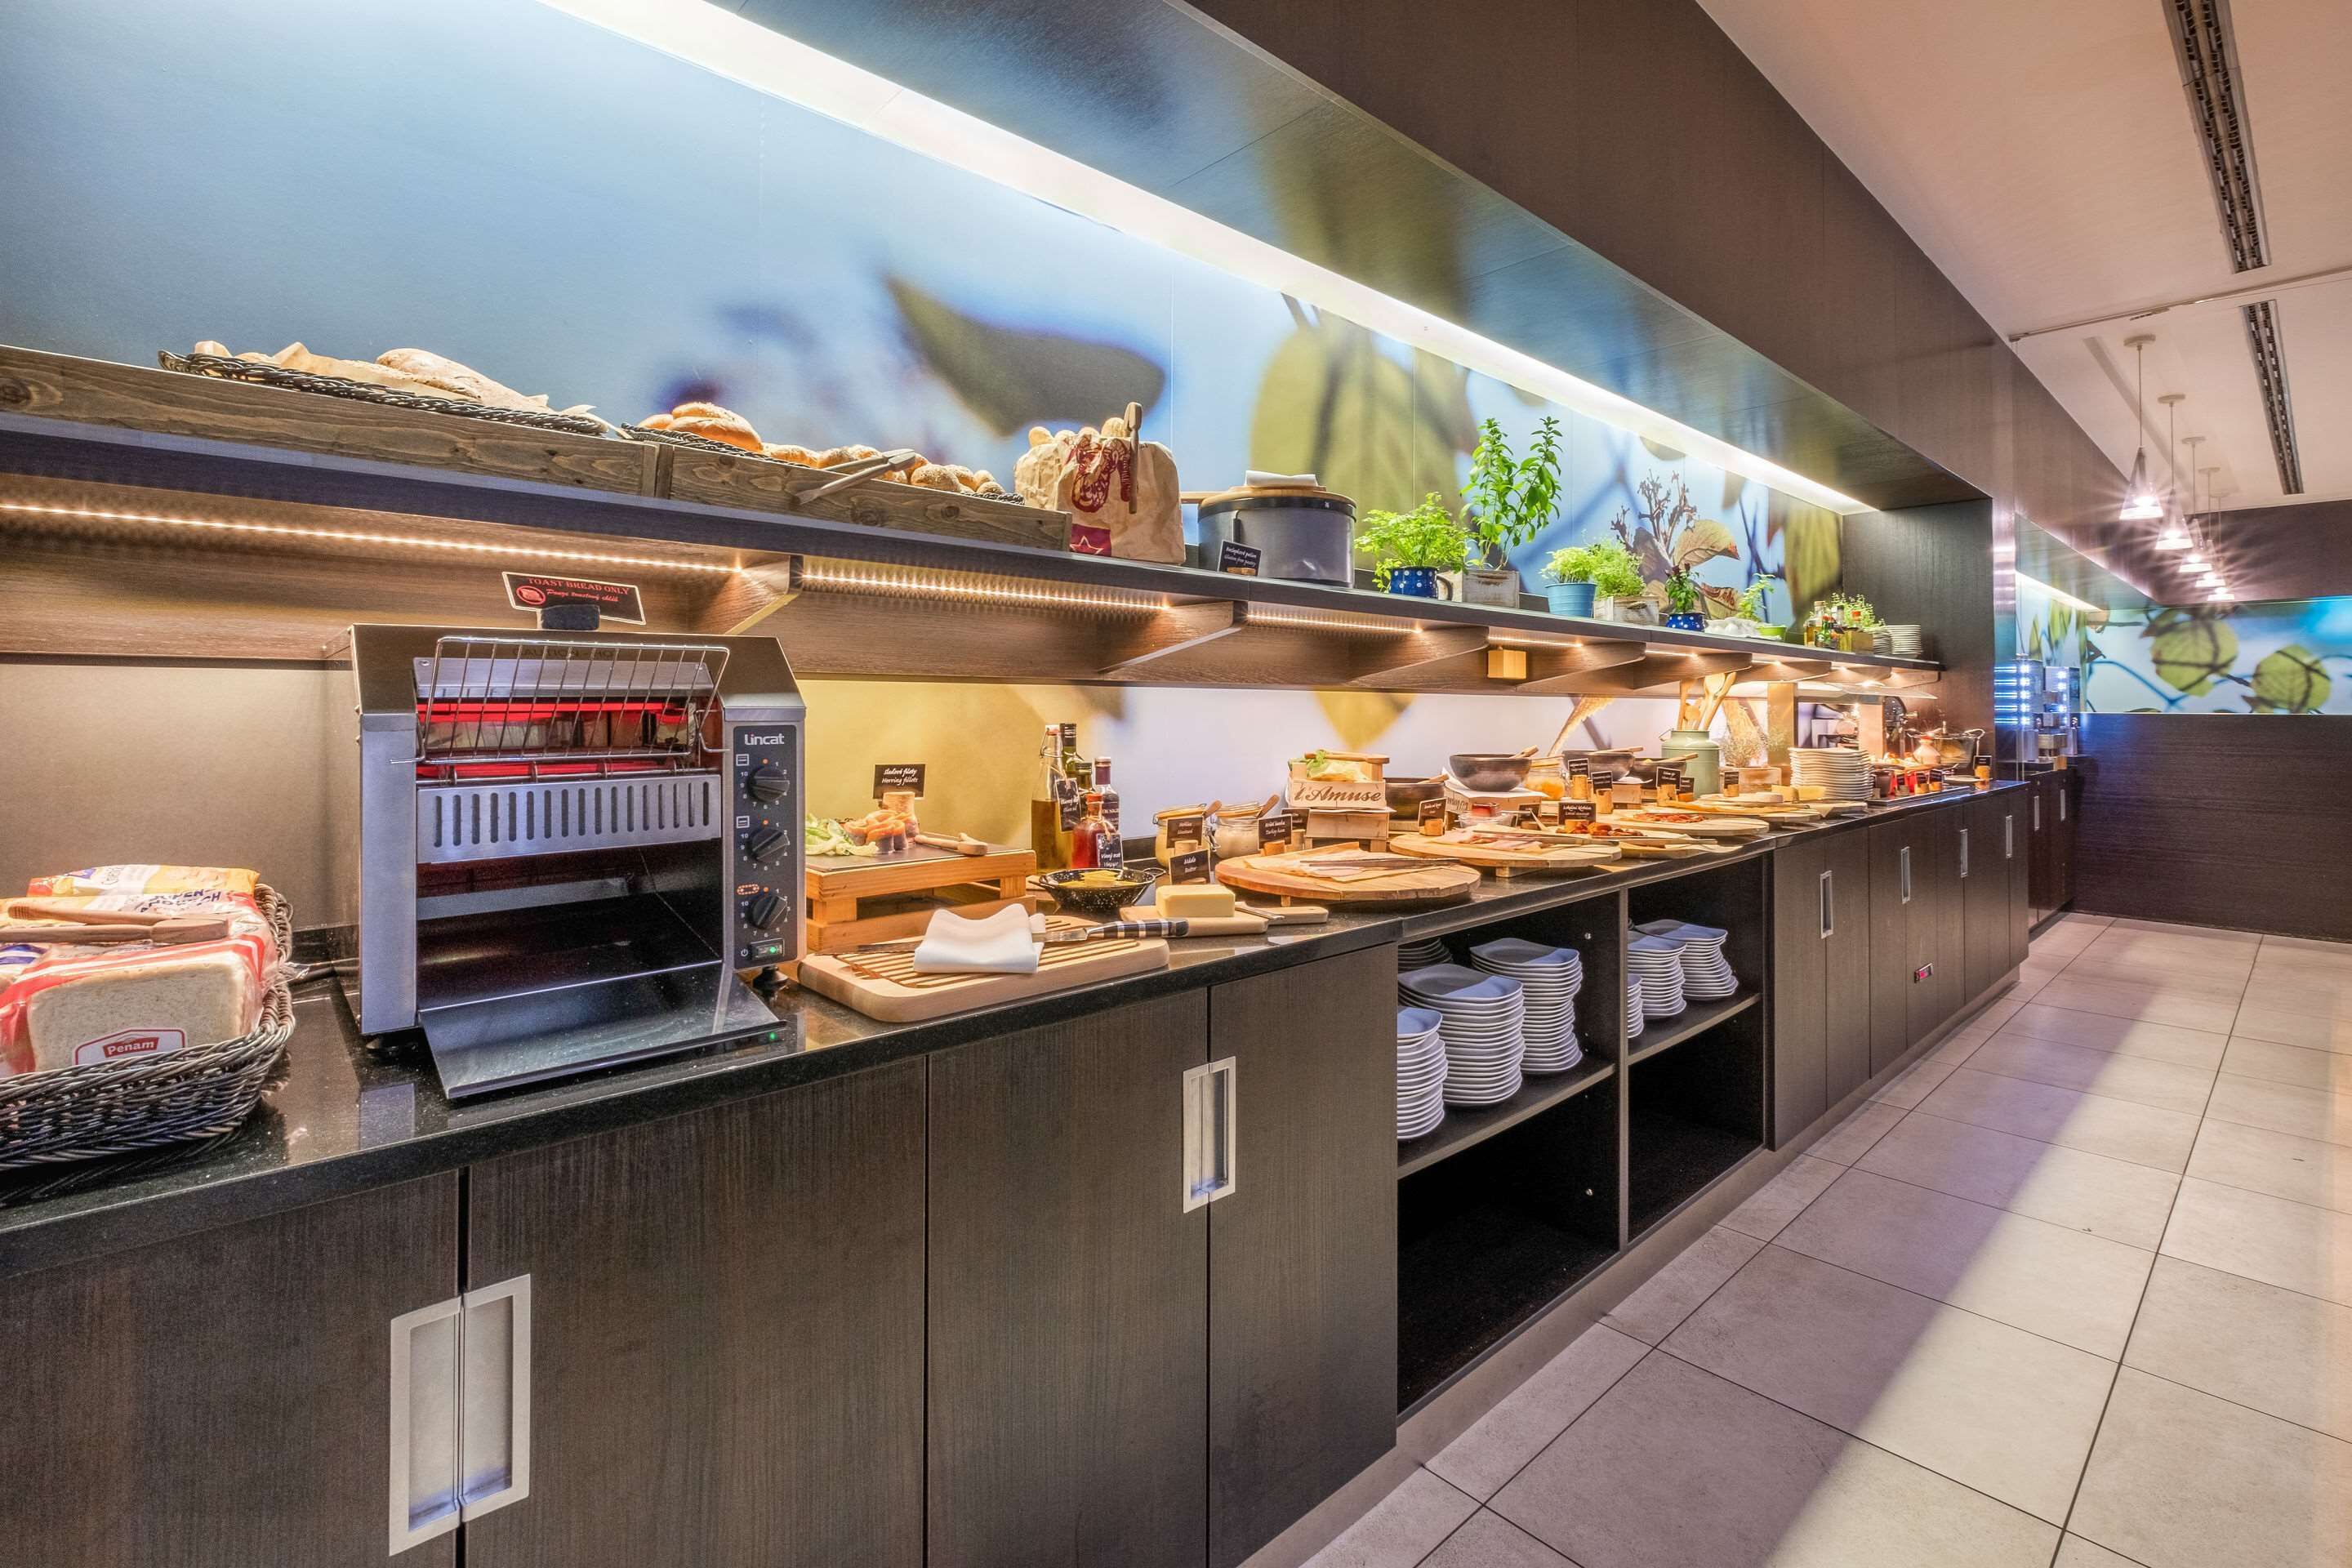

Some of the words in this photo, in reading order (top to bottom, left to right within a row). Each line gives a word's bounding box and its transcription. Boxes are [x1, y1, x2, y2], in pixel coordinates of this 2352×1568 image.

[528, 577, 564, 587] TOAST
[565, 581, 603, 591] BREAD
[604, 586, 630, 595] ONLY
[1294, 785, 1382, 802] l'Amuse
[106, 1041, 155, 1056] Penam
